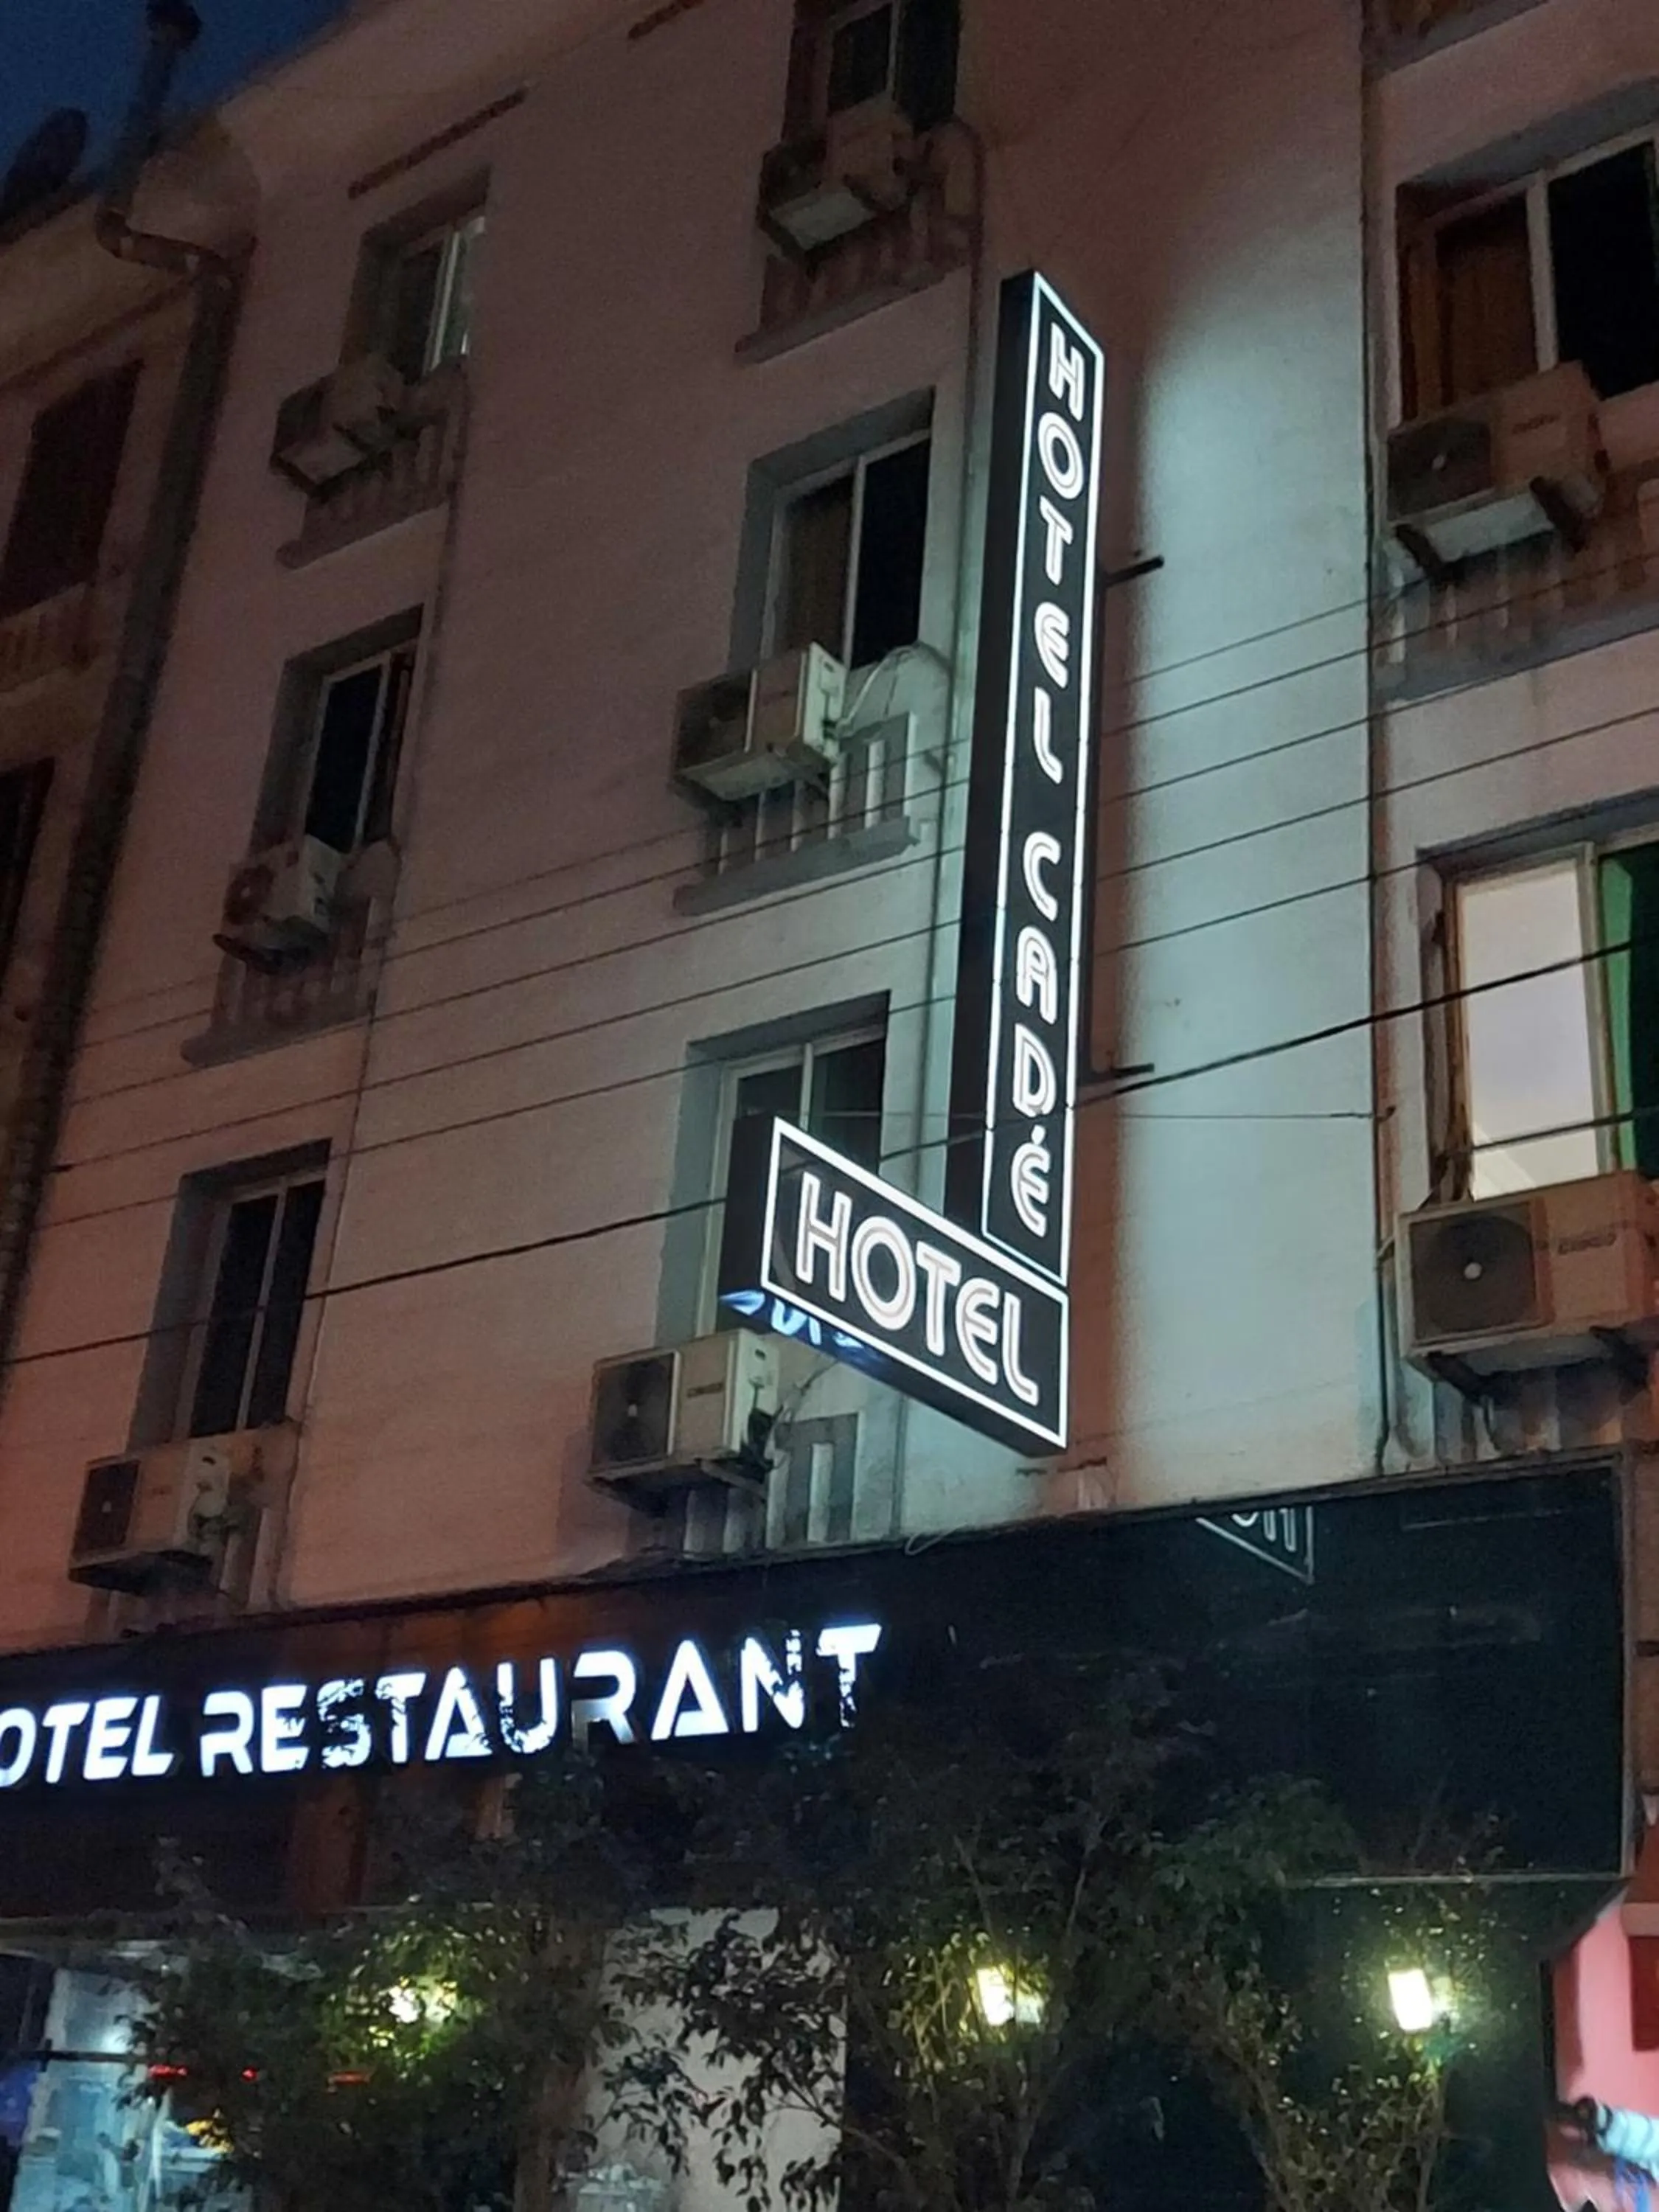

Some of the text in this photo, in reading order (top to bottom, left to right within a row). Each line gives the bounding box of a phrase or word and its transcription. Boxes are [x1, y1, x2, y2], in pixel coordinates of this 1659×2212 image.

[1034, 321, 1085, 785] HOTEL
[795, 1171, 1040, 1406] HOTEL
[199, 1623, 883, 1778] RESTAURANT
